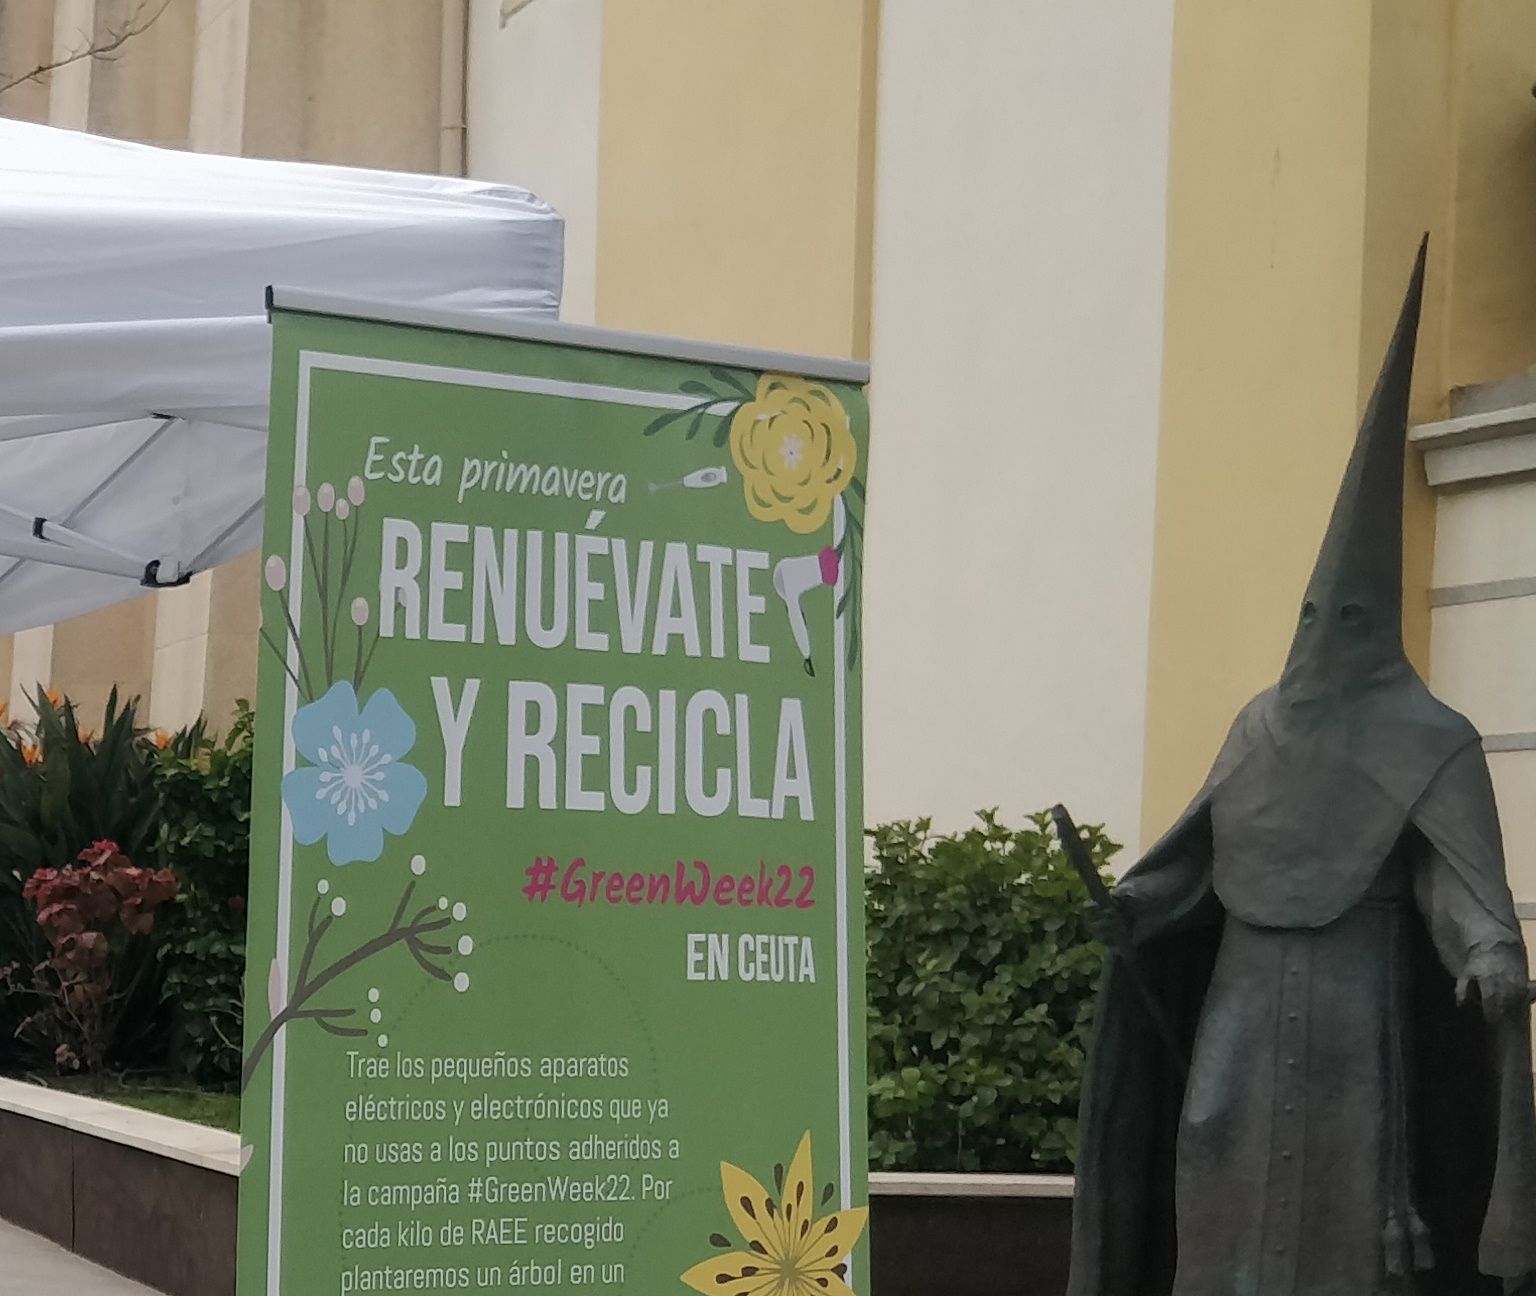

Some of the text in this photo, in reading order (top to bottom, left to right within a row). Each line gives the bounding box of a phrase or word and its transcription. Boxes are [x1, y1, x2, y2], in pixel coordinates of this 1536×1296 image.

[364, 436, 628, 505] Esta primavera
[379, 509, 770, 664] RENUÉVATE
[430, 676, 815, 822] Y RECICLA
[521, 856, 815, 909] #GreenWeek22
[686, 932, 815, 984] EN CEUTA
[346, 1052, 629, 1084] Trae los pequeños aparatos
[344, 1094, 669, 1126] eléctricos y electrónicos que ya
[344, 1135, 679, 1168] no usas a los puntos adheridos a
[343, 1174, 673, 1210] la campaña #GreenWeek22. Por
[342, 1216, 624, 1250] cada kilo de RAEE recogido
[341, 1261, 624, 1296] plantaremos un árbol en un
